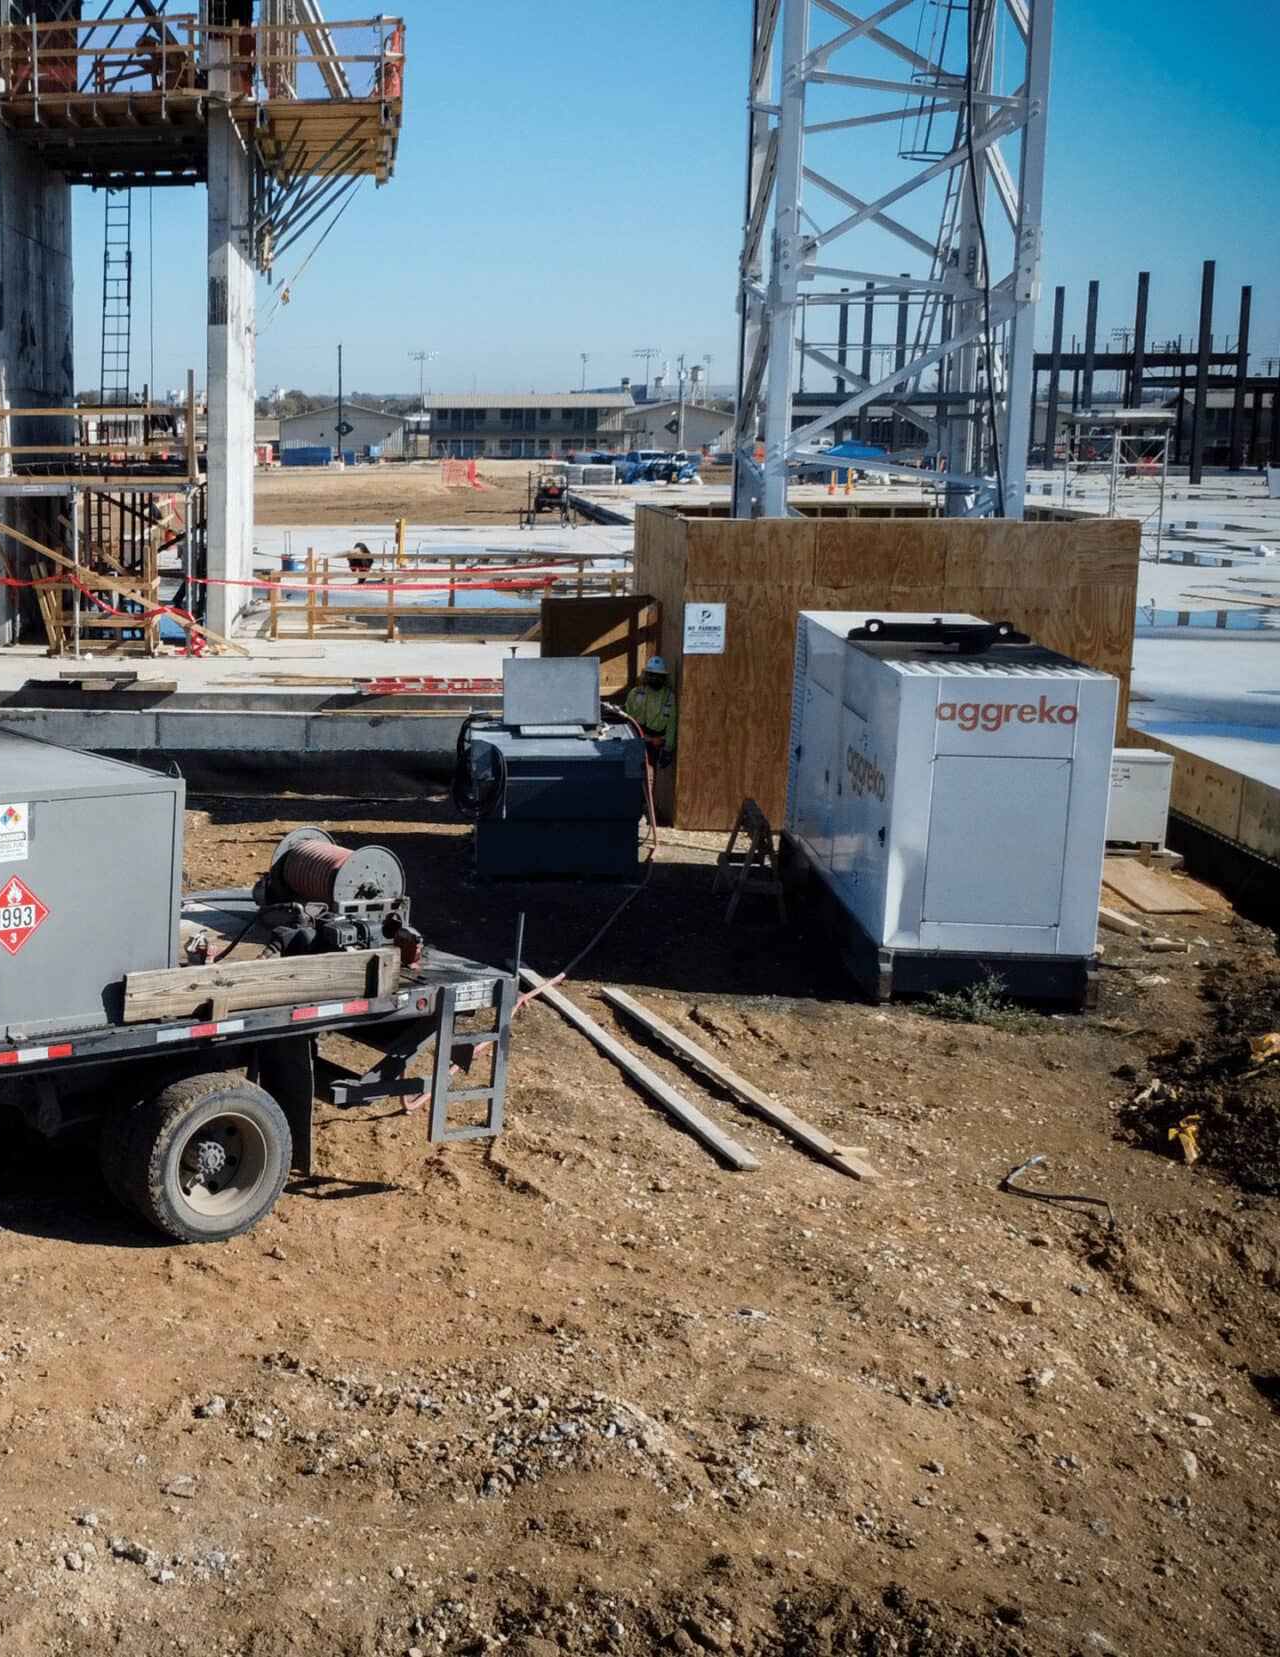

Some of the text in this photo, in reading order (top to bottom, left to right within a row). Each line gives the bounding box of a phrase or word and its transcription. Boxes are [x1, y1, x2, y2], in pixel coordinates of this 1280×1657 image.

[937, 695, 1078, 732] aggreko
[847, 744, 885, 802] aggreko
[10, 932, 18, 944] 3
